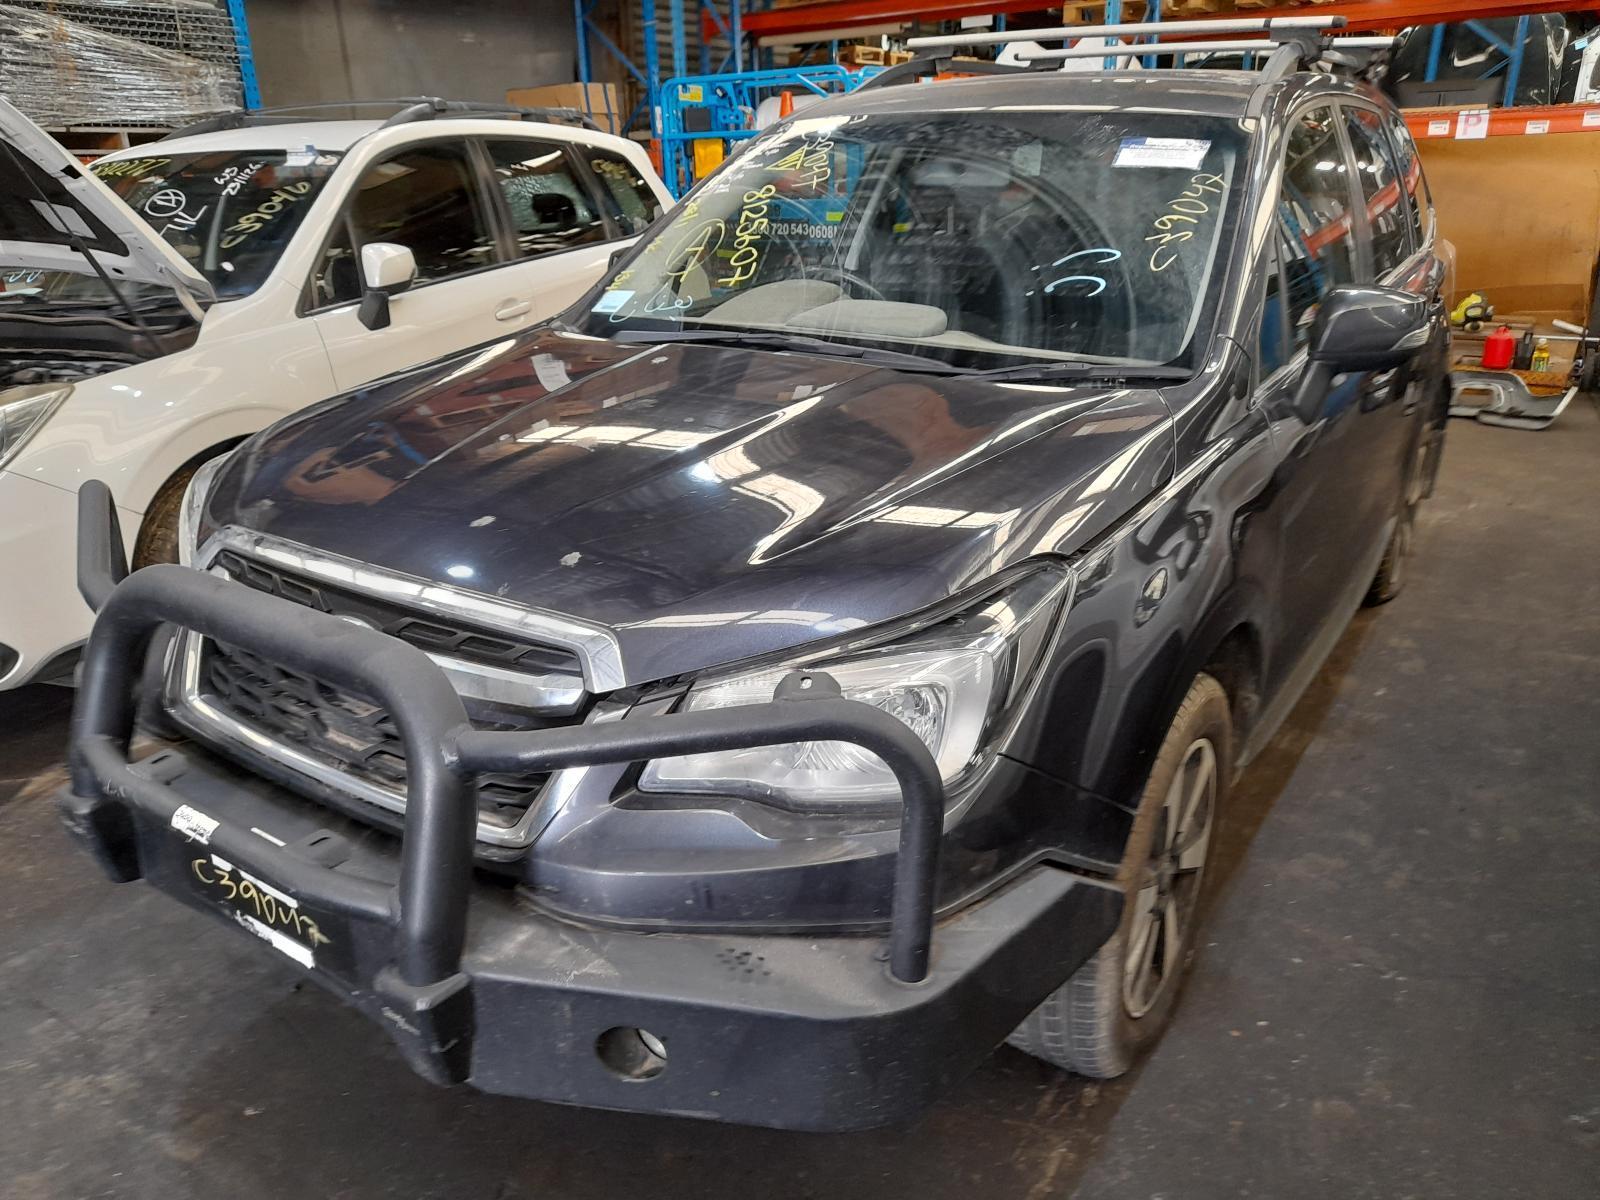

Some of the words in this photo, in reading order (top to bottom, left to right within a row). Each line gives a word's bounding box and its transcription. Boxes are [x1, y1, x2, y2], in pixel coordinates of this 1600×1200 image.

[1462, 114, 1482, 136] P
[771, 223, 789, 235] 720
[791, 223, 809, 235] 543
[1145, 173, 1228, 271] C39047
